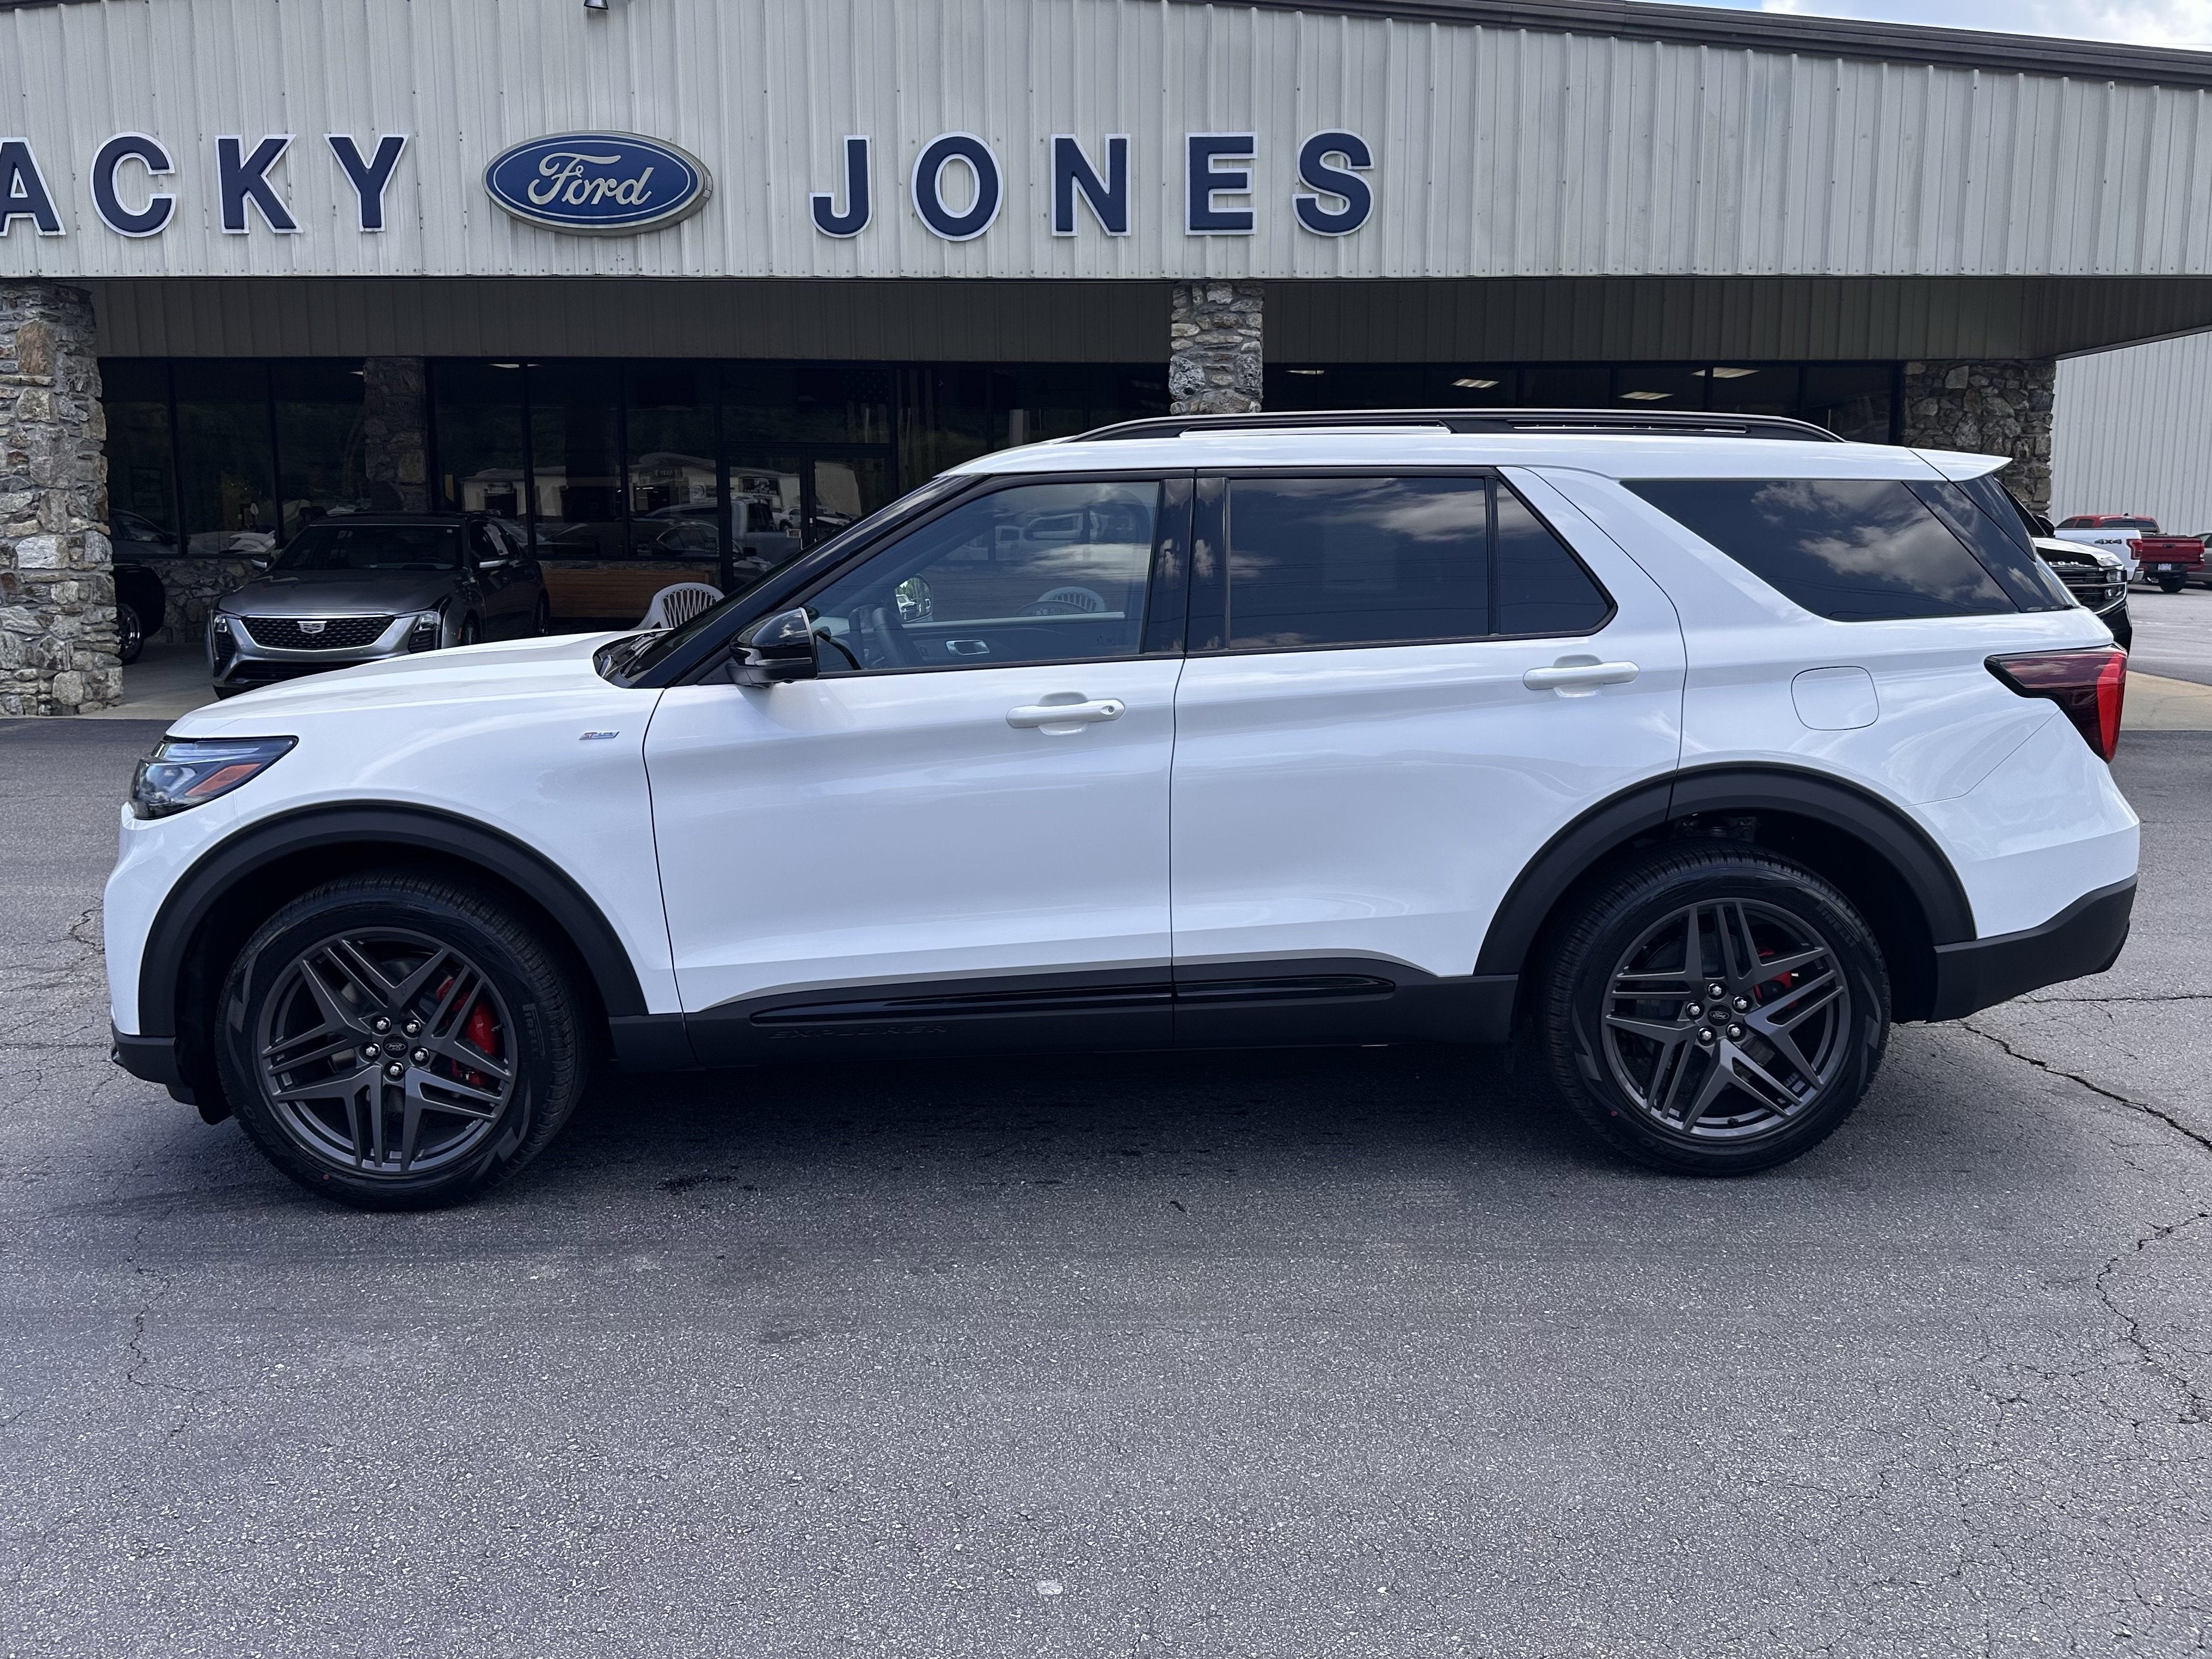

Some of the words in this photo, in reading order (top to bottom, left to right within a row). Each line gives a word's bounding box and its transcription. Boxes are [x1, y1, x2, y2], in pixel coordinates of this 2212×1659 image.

[0, 131, 410, 238] ACKY
[526, 152, 655, 207] Ford
[809, 128, 1375, 241] JONES
[768, 1025, 948, 1039] EXPLORER
